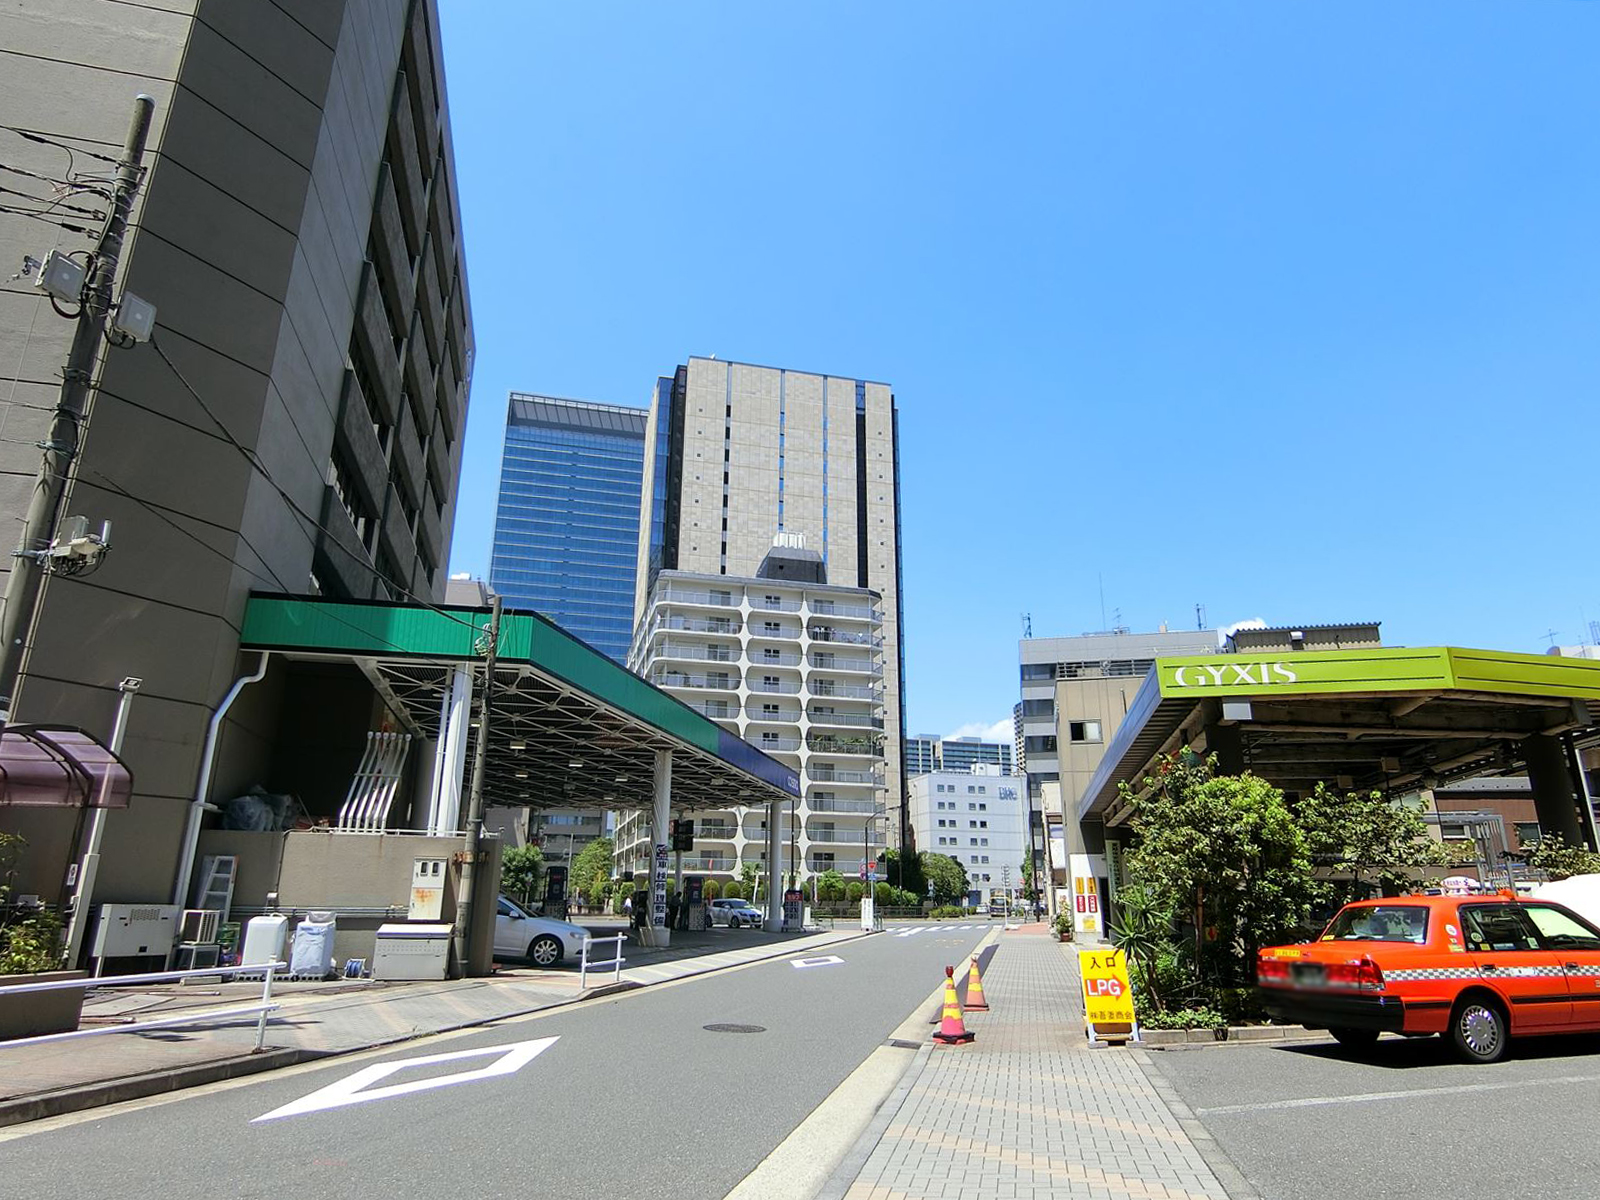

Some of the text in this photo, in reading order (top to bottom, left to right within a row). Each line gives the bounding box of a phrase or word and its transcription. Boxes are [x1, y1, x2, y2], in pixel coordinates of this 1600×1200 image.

[1175, 662, 1297, 687] GYXIS
[1090, 957, 1116, 969] 入口
[1087, 979, 1121, 996] LPG
